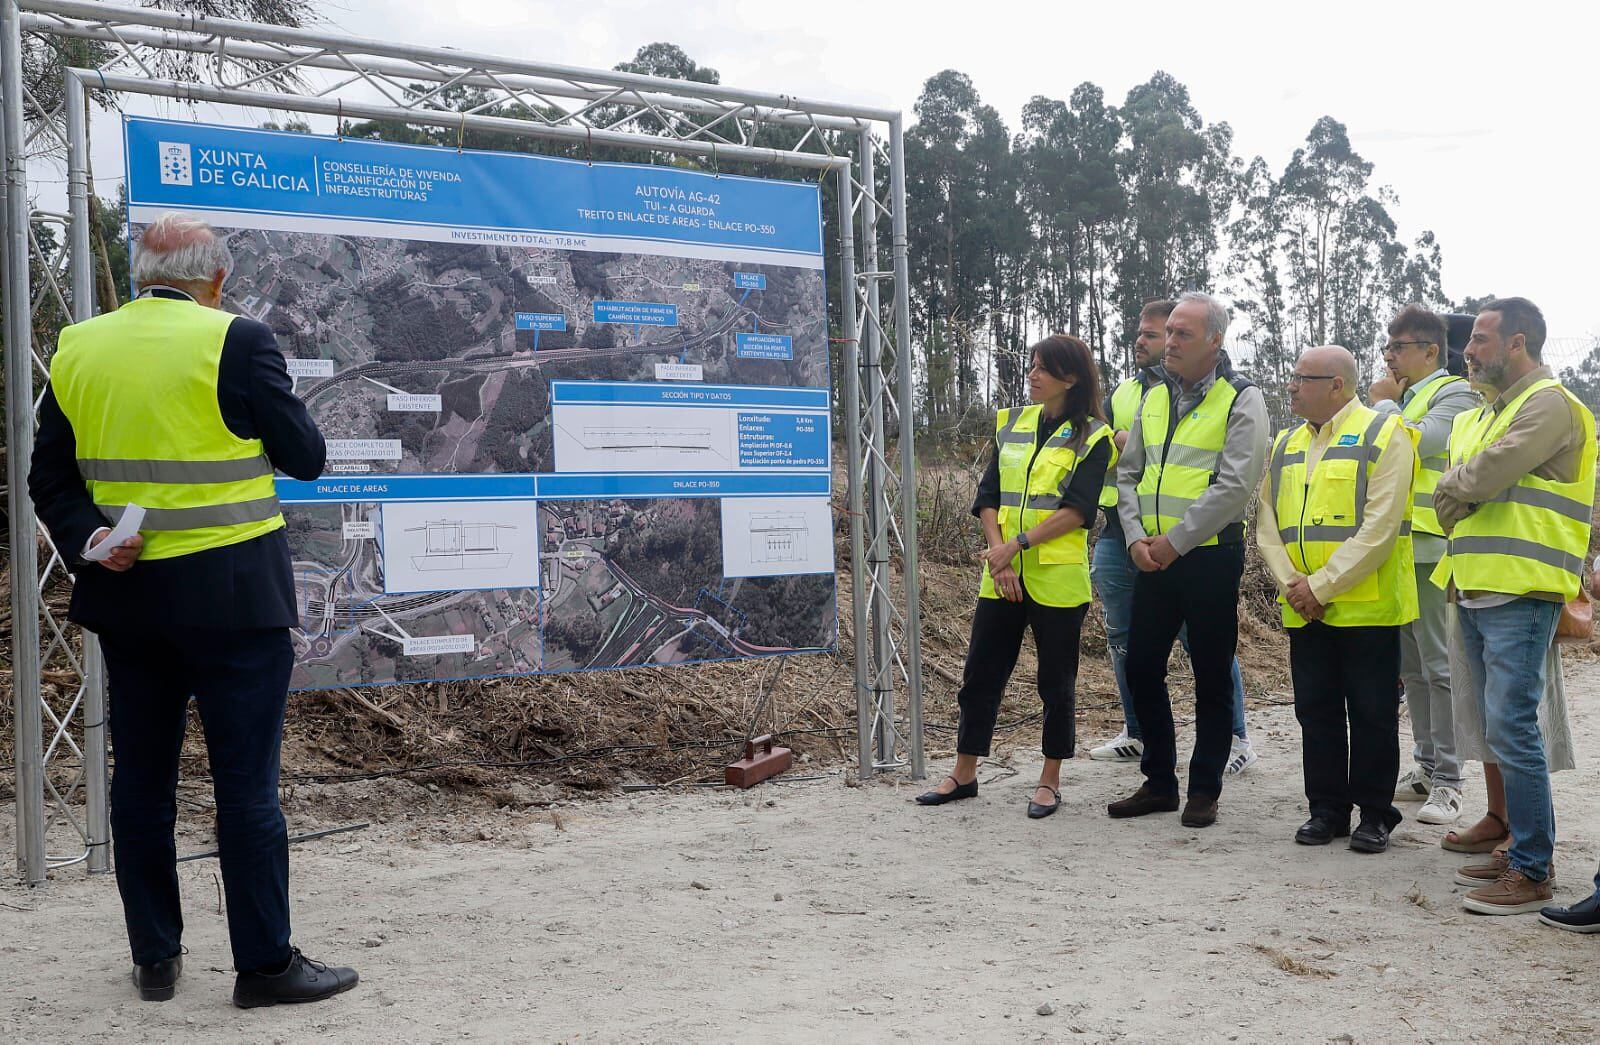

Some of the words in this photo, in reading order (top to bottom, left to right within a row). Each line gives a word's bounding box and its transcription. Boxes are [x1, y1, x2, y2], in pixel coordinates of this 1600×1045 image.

[198, 148, 268, 170] XUNTA
[199, 169, 226, 186] DE
[231, 171, 310, 193] GALICIA
[323, 160, 397, 178] CONSELLERÍA
[399, 167, 413, 179] DE
[415, 168, 462, 183] VIVENDA
[324, 172, 331, 182] E
[333, 172, 416, 190] PLANIFICACIÓN
[419, 181, 433, 192] DE
[325, 183, 428, 202] INFRAESTRUTURAS
[635, 185, 687, 201] AUTOVÍA
[689, 192, 721, 206] AG-42
[643, 200, 660, 211] TUI
[668, 203, 676, 213] A
[678, 204, 715, 217] GUARDA
[577, 208, 615, 221] TREITO
[617, 211, 655, 224] ENLACE
[657, 213, 669, 224] DE
[671, 215, 700, 228] AREAS
[708, 218, 743, 232] ENLACE
[744, 221, 776, 235] PO-350
[451, 231, 518, 243] INVESTIMENTO
[521, 235, 552, 245] TOTAL:
[555, 237, 572, 246] 17,8
[661, 389, 689, 399] SECCIÓN
[689, 392, 705, 400] TIPO
[706, 392, 710, 400] Y
[710, 392, 732, 401] DATOS
[317, 485, 349, 494] ENLACE
[350, 485, 361, 493] DE
[362, 484, 388, 493] AREAS
[673, 481, 697, 489] ENLACE
[698, 480, 721, 488] PO-350
